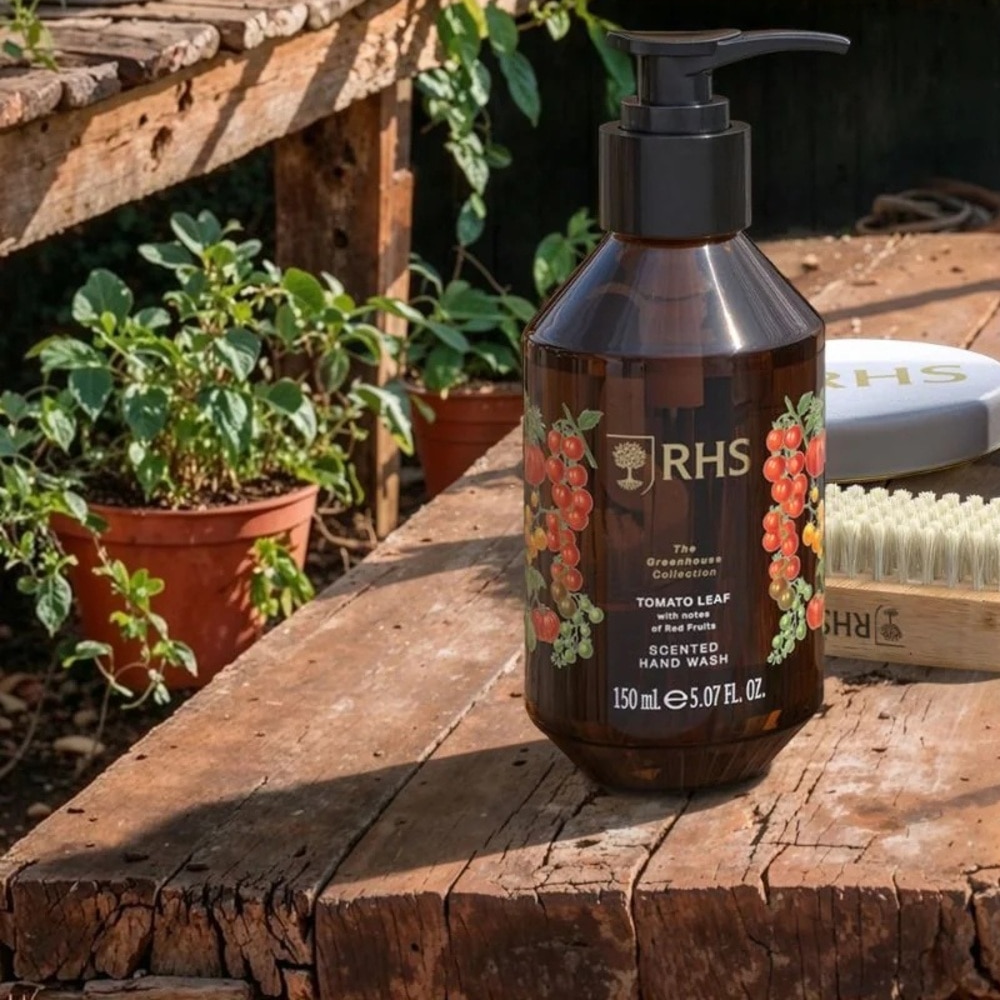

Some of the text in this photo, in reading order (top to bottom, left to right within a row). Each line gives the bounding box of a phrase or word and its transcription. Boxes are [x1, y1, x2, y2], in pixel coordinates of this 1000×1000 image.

[661, 437, 751, 480] RHS
[673, 544, 697, 554] The
[646, 556, 722, 567] Greenhouse
[652, 568, 718, 580] Collection
[636, 592, 731, 608] TOMATO LEAF
[657, 611, 711, 620] with notes
[651, 622, 717, 633] of Red Fruits
[649, 642, 719, 656] SCENTED
[639, 654, 729, 669] HAND WASH
[613, 686, 638, 710] 150
[690, 684, 721, 709] 5.07
[724, 682, 743, 705] FL.
